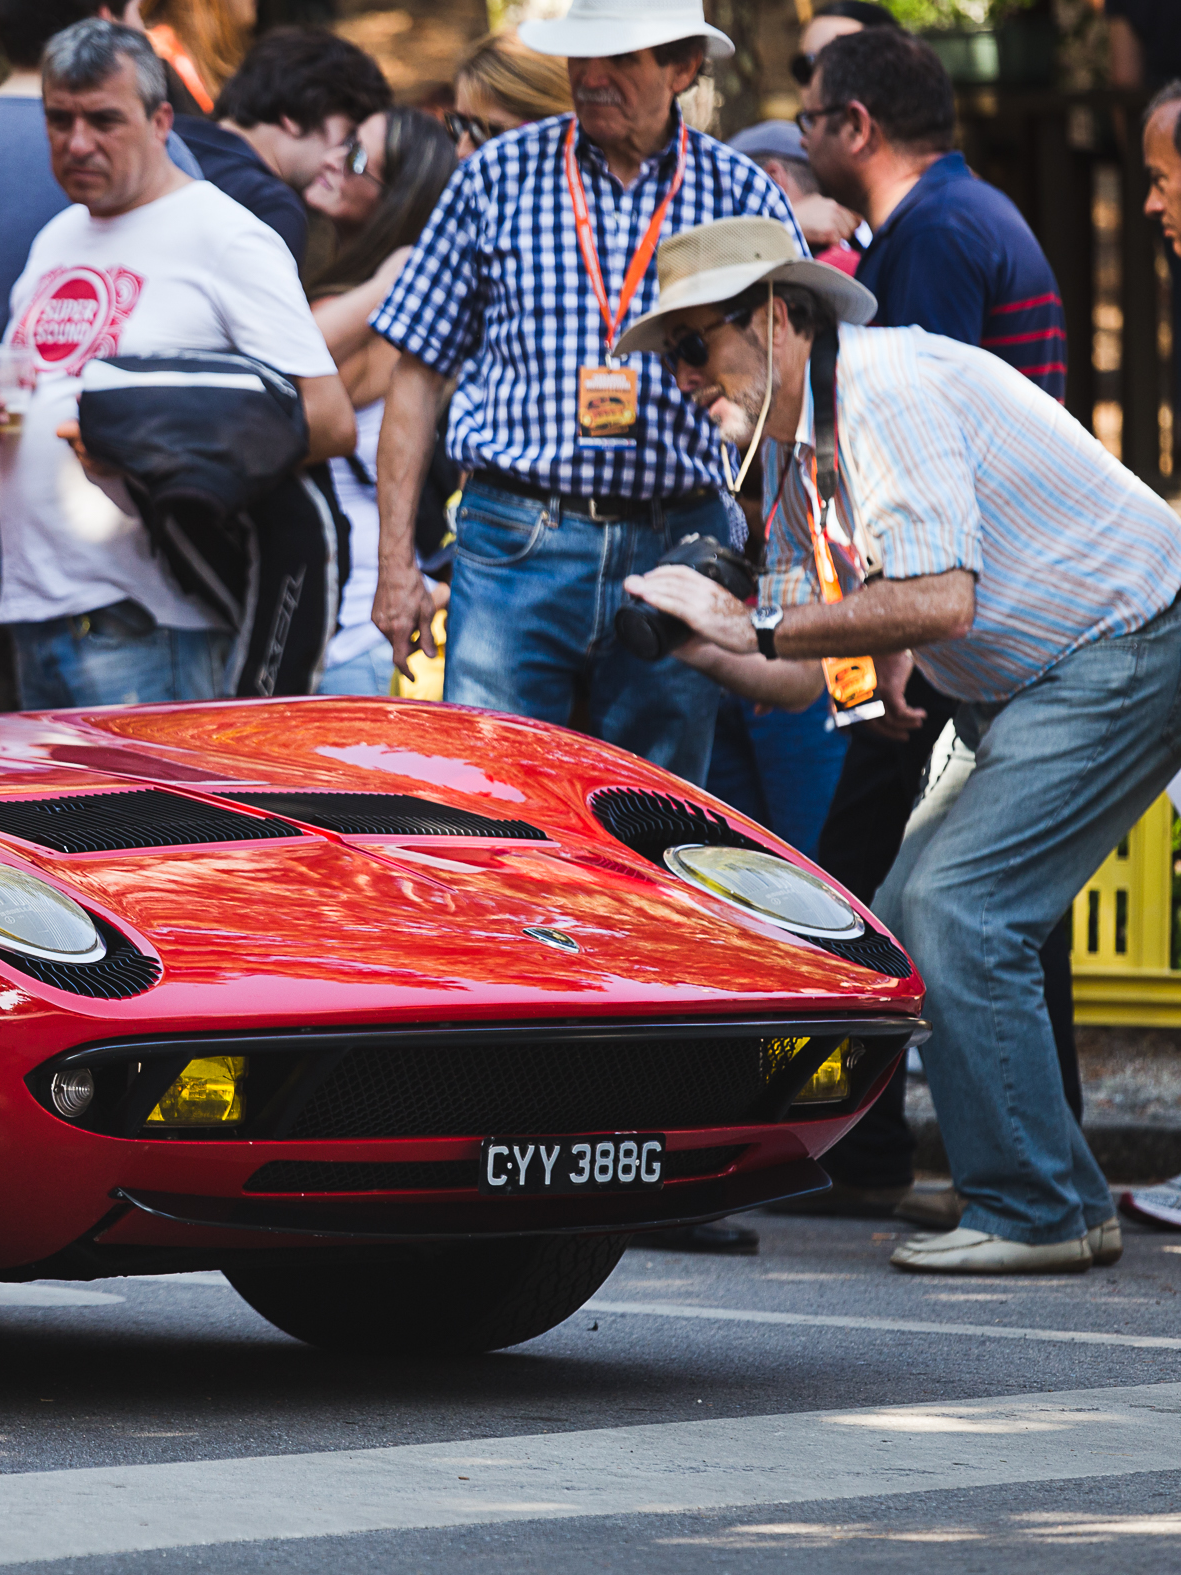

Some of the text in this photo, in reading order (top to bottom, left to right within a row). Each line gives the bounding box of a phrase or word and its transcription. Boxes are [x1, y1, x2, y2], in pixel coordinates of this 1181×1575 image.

[41, 298, 99, 321] SUPER
[486, 1140, 662, 1186] CYY 388G
